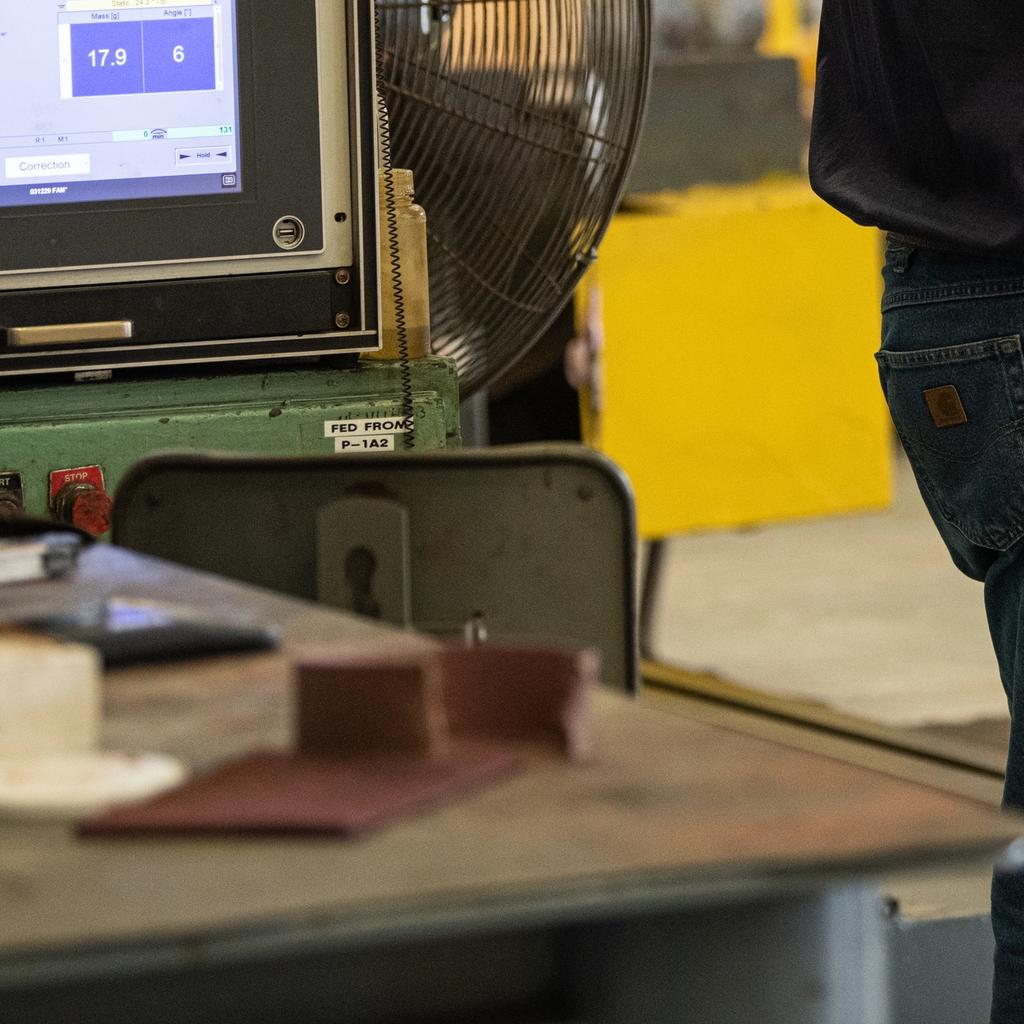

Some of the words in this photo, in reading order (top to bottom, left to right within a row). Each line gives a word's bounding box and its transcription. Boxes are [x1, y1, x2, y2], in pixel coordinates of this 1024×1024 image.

[91, 12, 110, 21] Mass
[163, 9, 183, 19] Angle
[87, 47, 128, 68] 17.9
[172, 44, 186, 63] 6
[219, 126, 232, 135] 131
[19, 160, 71, 172] Correction
[331, 423, 358, 434] FED
[364, 420, 406, 432] FROM
[64, 471, 89, 483] STOP
